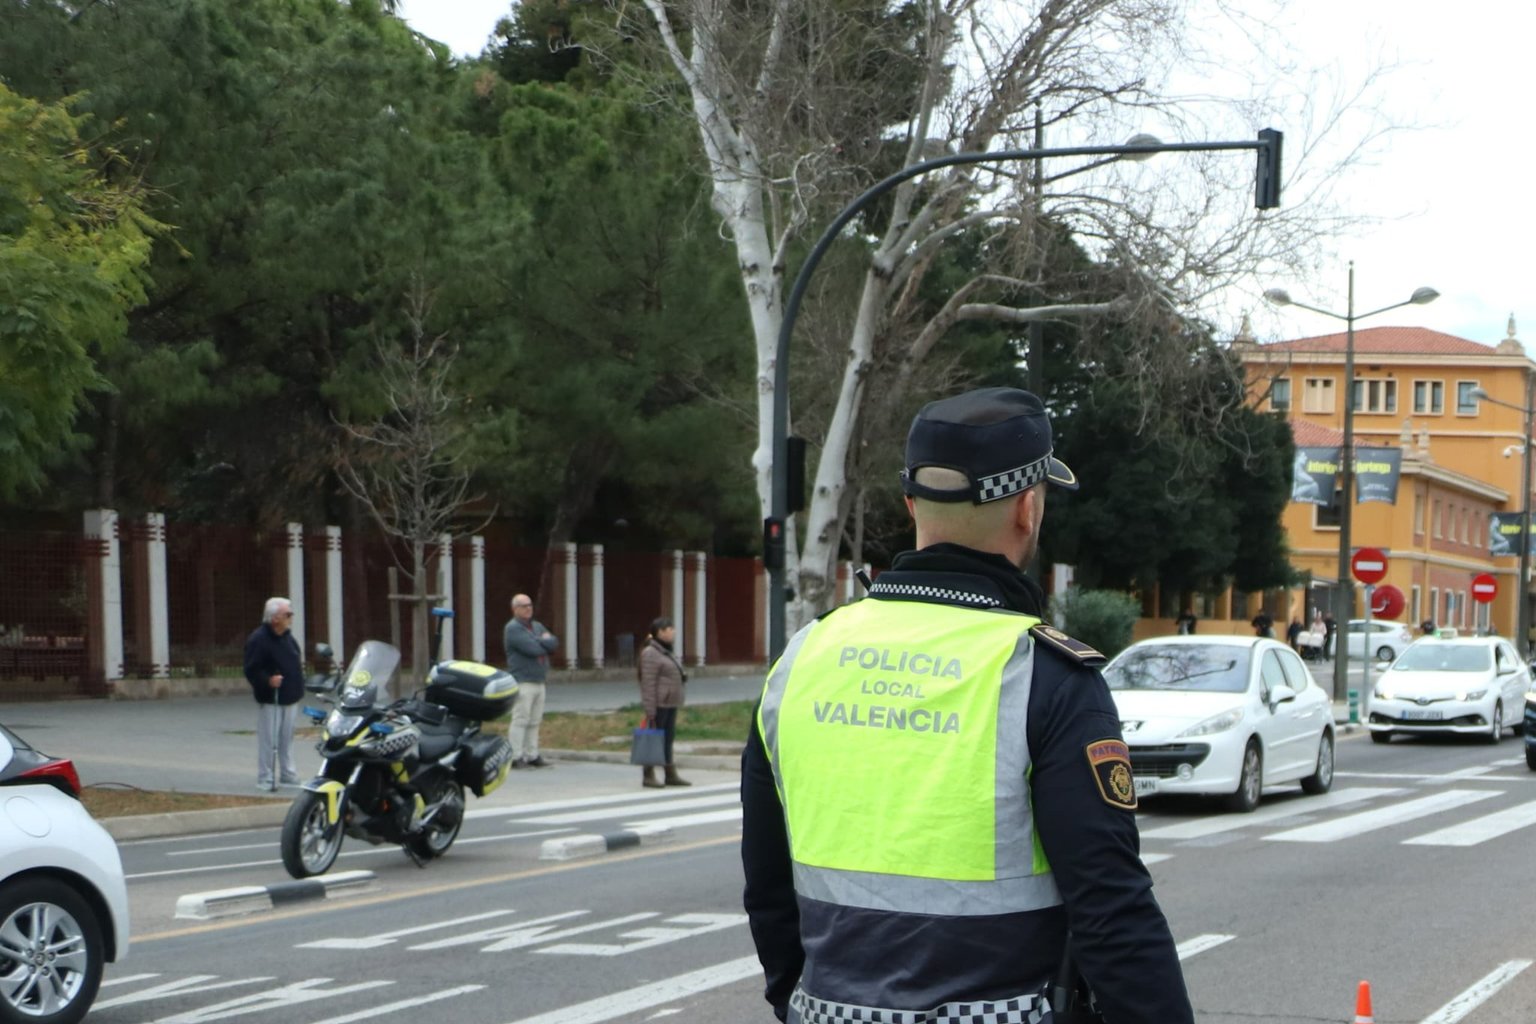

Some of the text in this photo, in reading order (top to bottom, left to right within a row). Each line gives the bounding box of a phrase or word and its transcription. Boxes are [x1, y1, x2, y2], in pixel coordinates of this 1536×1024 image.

[838, 646, 962, 680] POLICIA
[861, 680, 926, 699] LOCAL
[813, 701, 960, 734] VALENCIA
